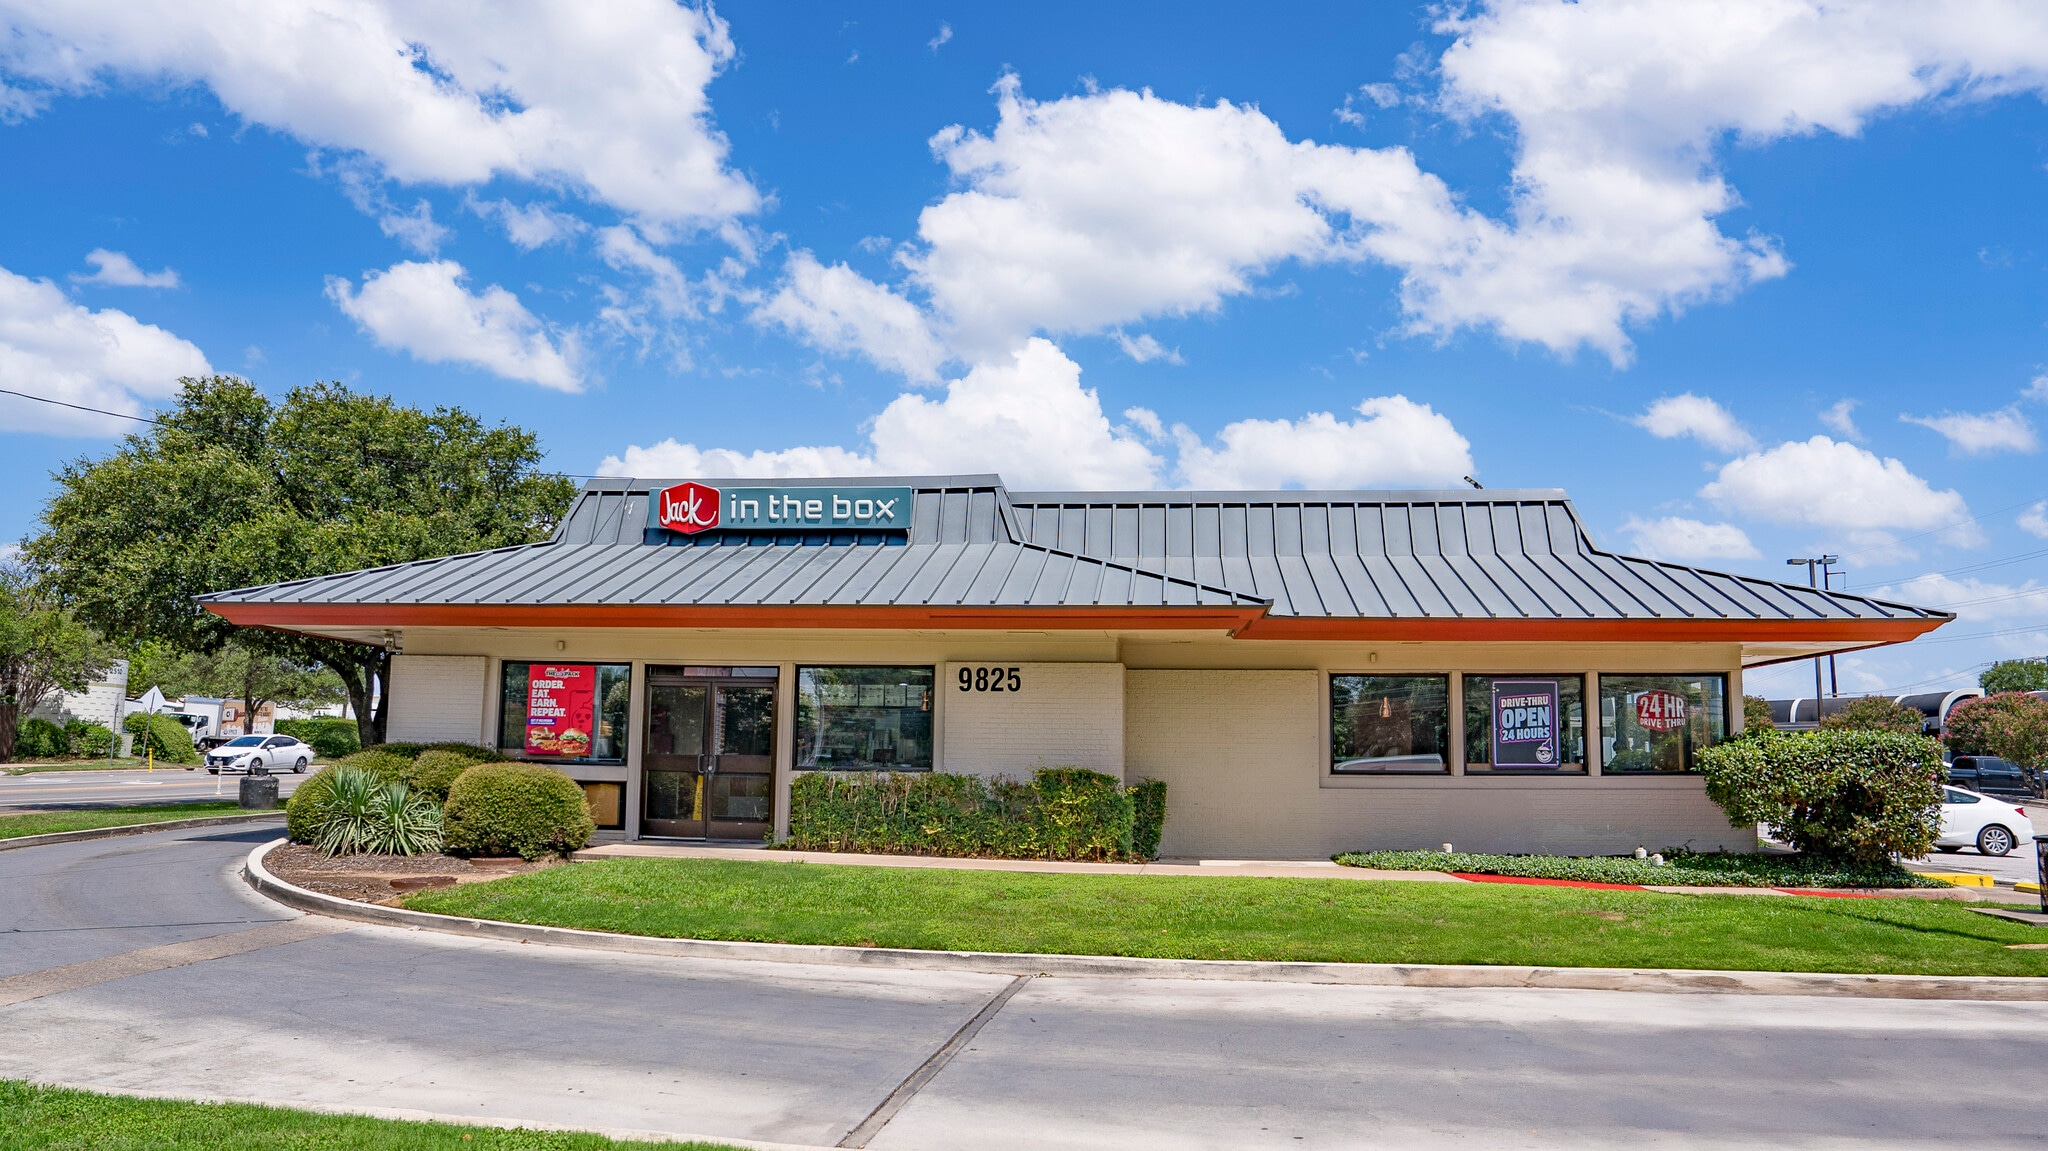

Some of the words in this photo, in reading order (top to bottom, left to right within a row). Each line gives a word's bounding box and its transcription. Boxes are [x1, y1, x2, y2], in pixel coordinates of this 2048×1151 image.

[661, 488, 717, 525] Jack
[730, 494, 759, 519] in
[769, 495, 823, 519] the
[833, 495, 895, 519] box
[532, 680, 565, 689] ORDER.
[958, 667, 1022, 692] 9825
[531, 689, 550, 698] EAT.
[531, 698, 558, 707] EARN.
[1501, 696, 1549, 707] DRIVE-THRU
[1640, 694, 1661, 717] 24
[1664, 693, 1685, 717] HR
[530, 707, 566, 717] REPEAT.
[1501, 706, 1550, 729] OPEN
[1640, 717, 1662, 728] DRIVE
[1665, 718, 1686, 728] THRU
[1502, 730, 1515, 740] 24
[1516, 727, 1550, 739] HOURS
